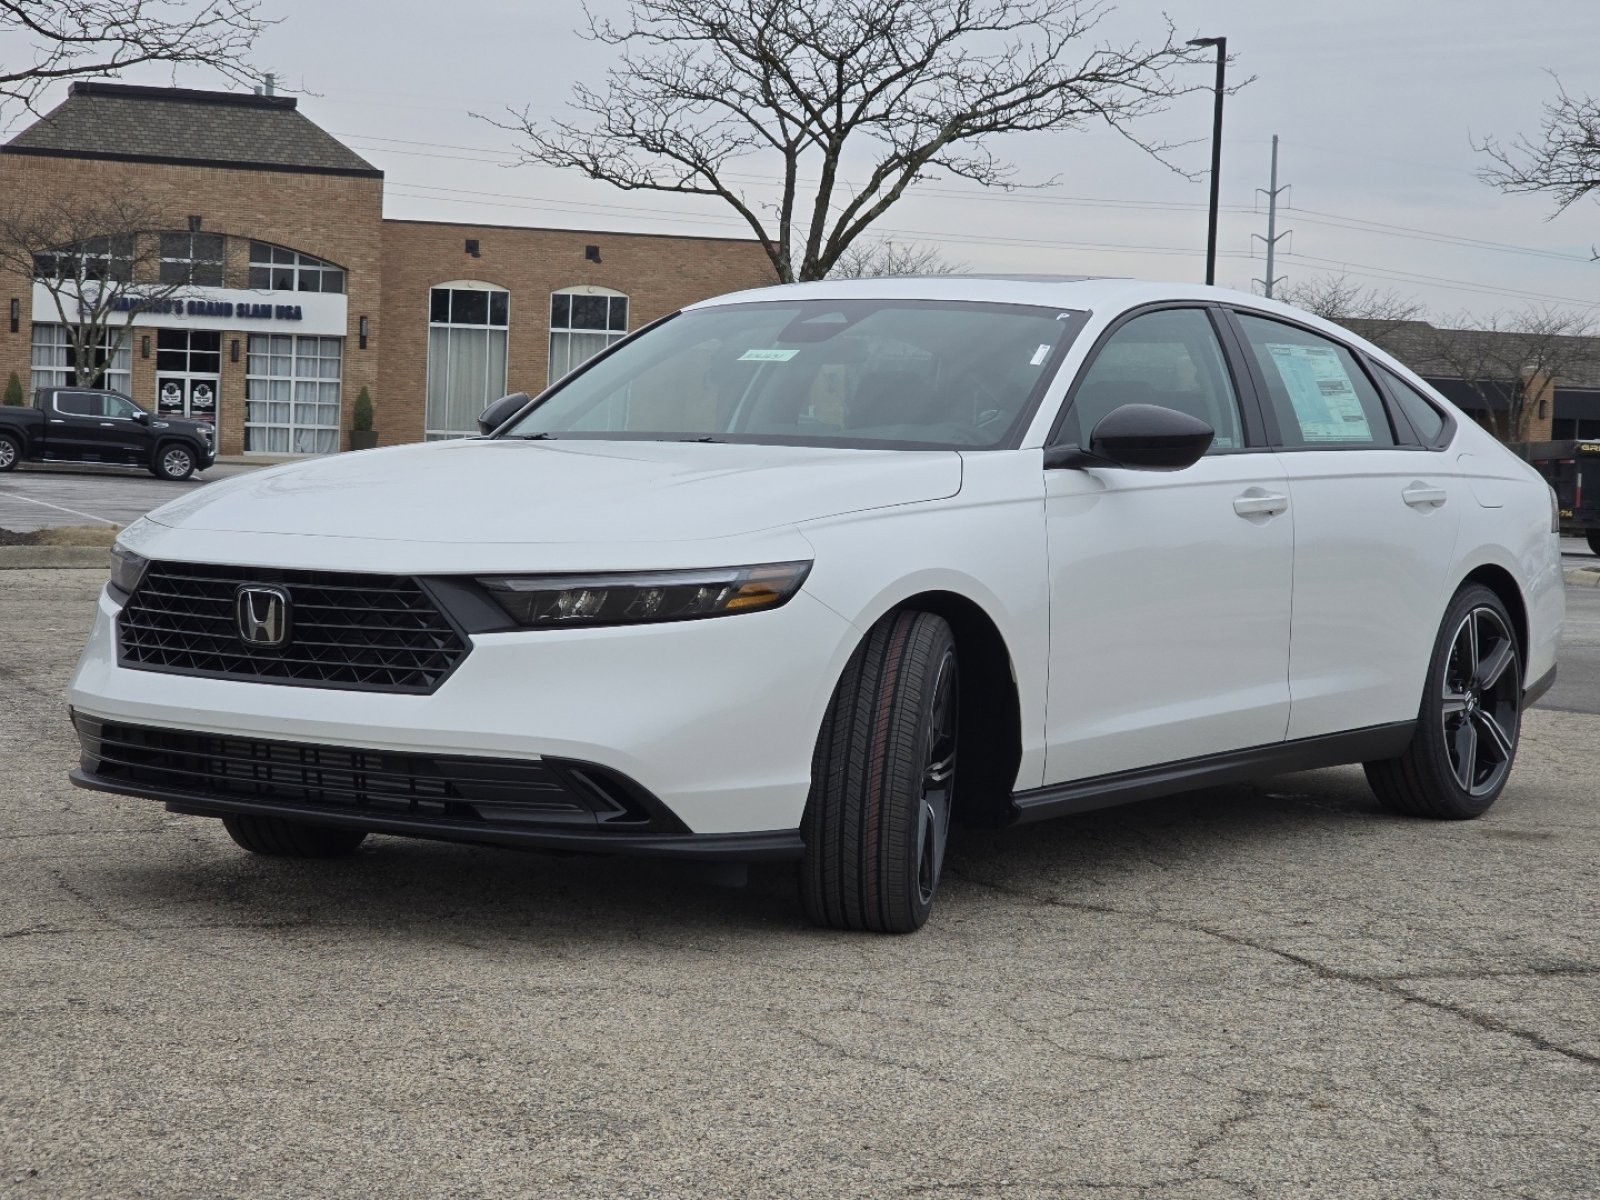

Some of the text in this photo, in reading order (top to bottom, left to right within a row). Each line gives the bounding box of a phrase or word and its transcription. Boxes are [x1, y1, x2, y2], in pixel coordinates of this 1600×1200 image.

[187, 300, 233, 317] GRAND
[236, 302, 272, 319] SLAM
[276, 305, 302, 320] USA
